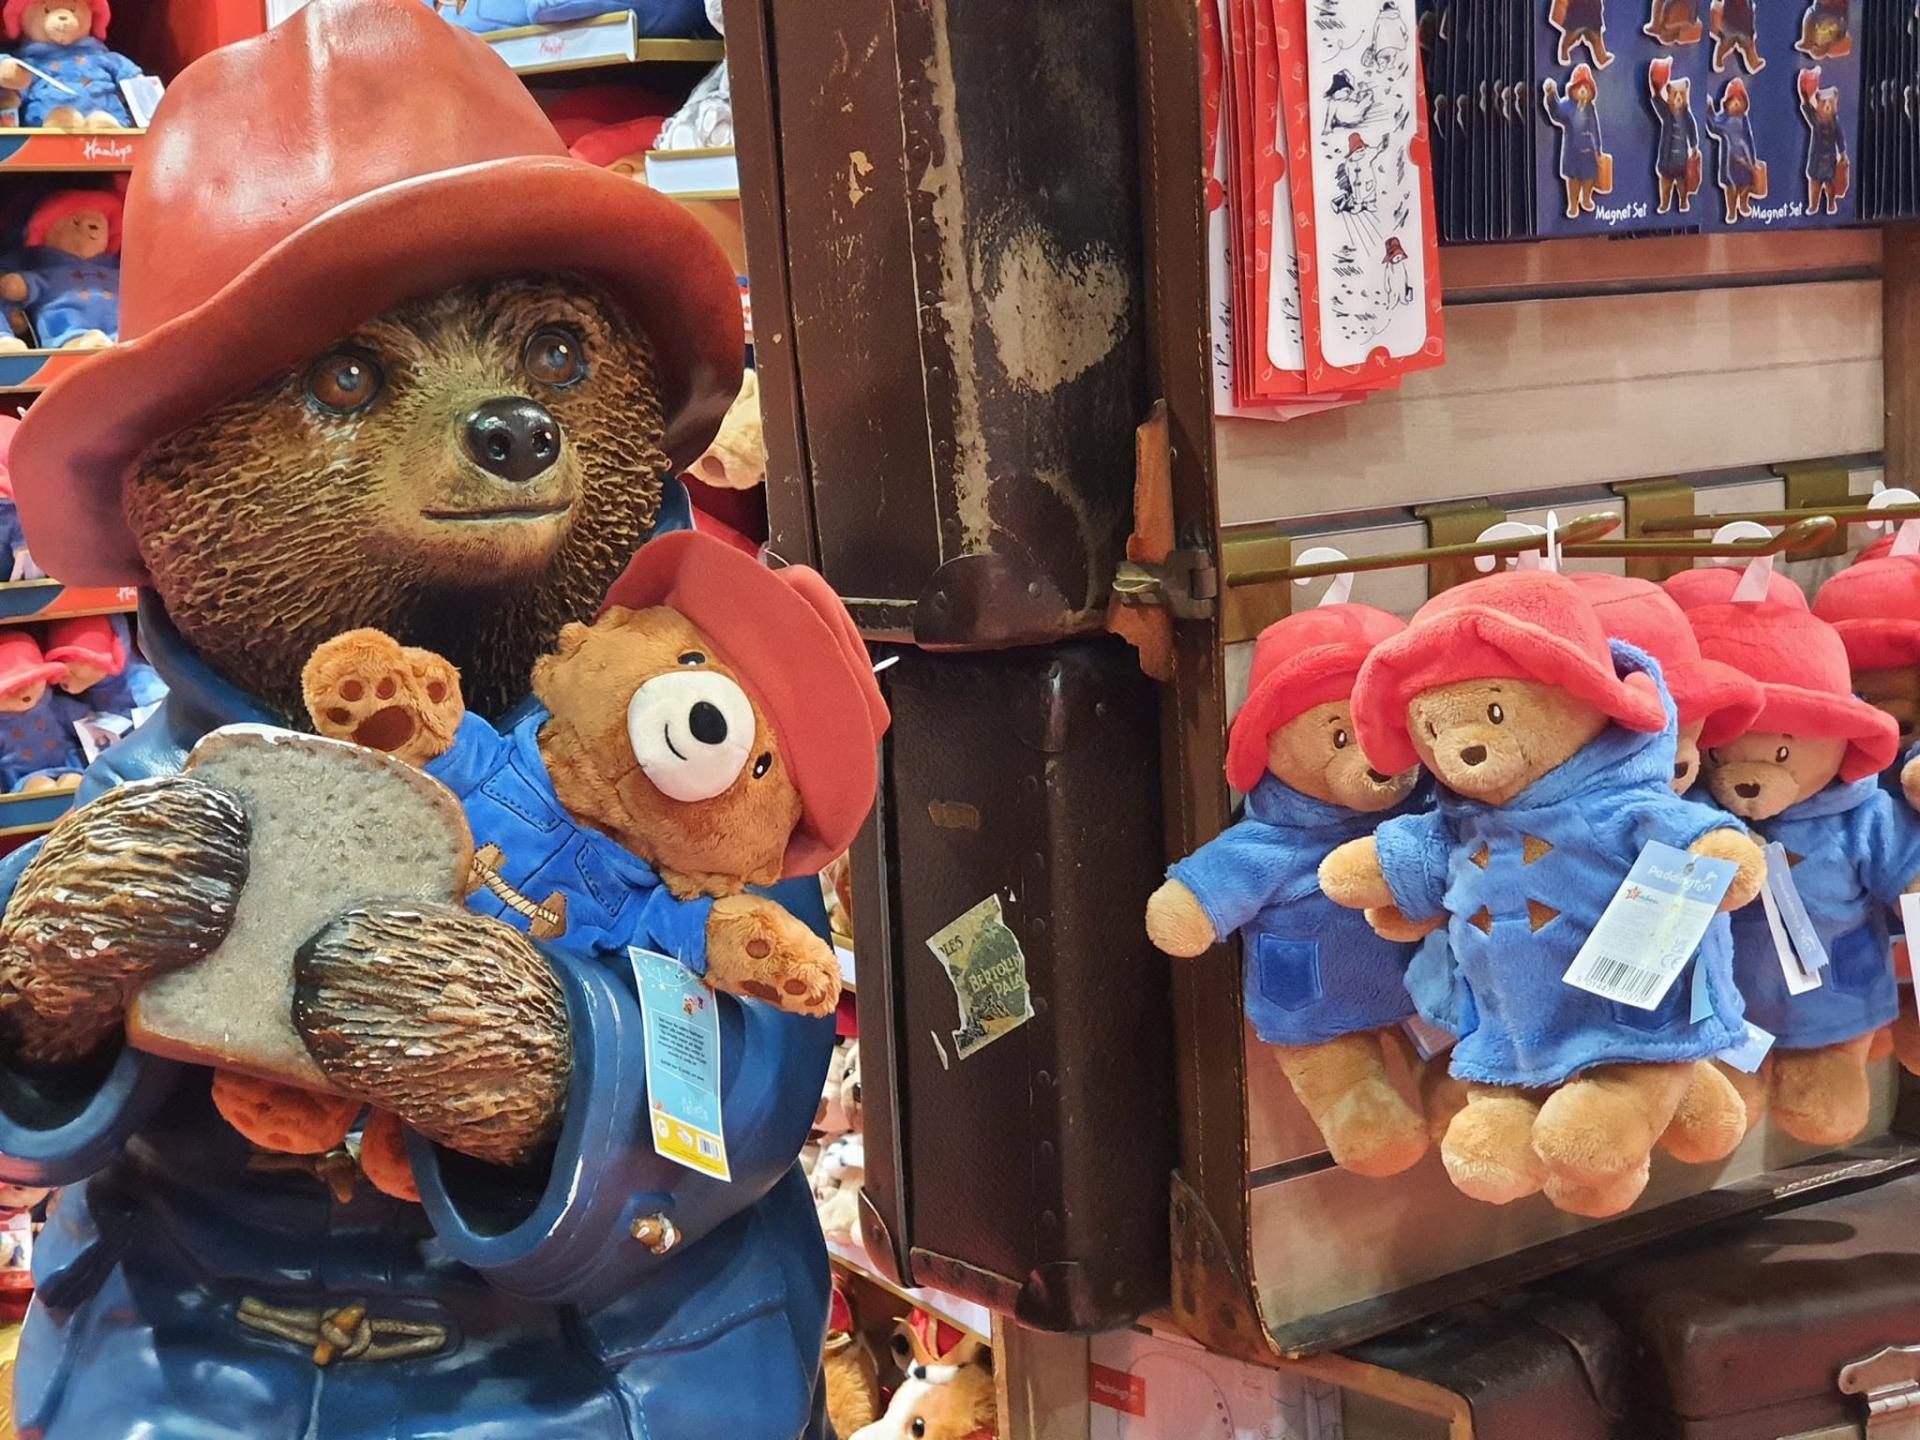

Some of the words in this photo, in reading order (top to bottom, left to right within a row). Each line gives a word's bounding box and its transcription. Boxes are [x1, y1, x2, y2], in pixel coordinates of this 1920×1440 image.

[1594, 204, 1631, 225] Magnet
[1632, 203, 1647, 218] Set
[1751, 204, 1787, 224] Magnet
[1788, 202, 1803, 217] Set
